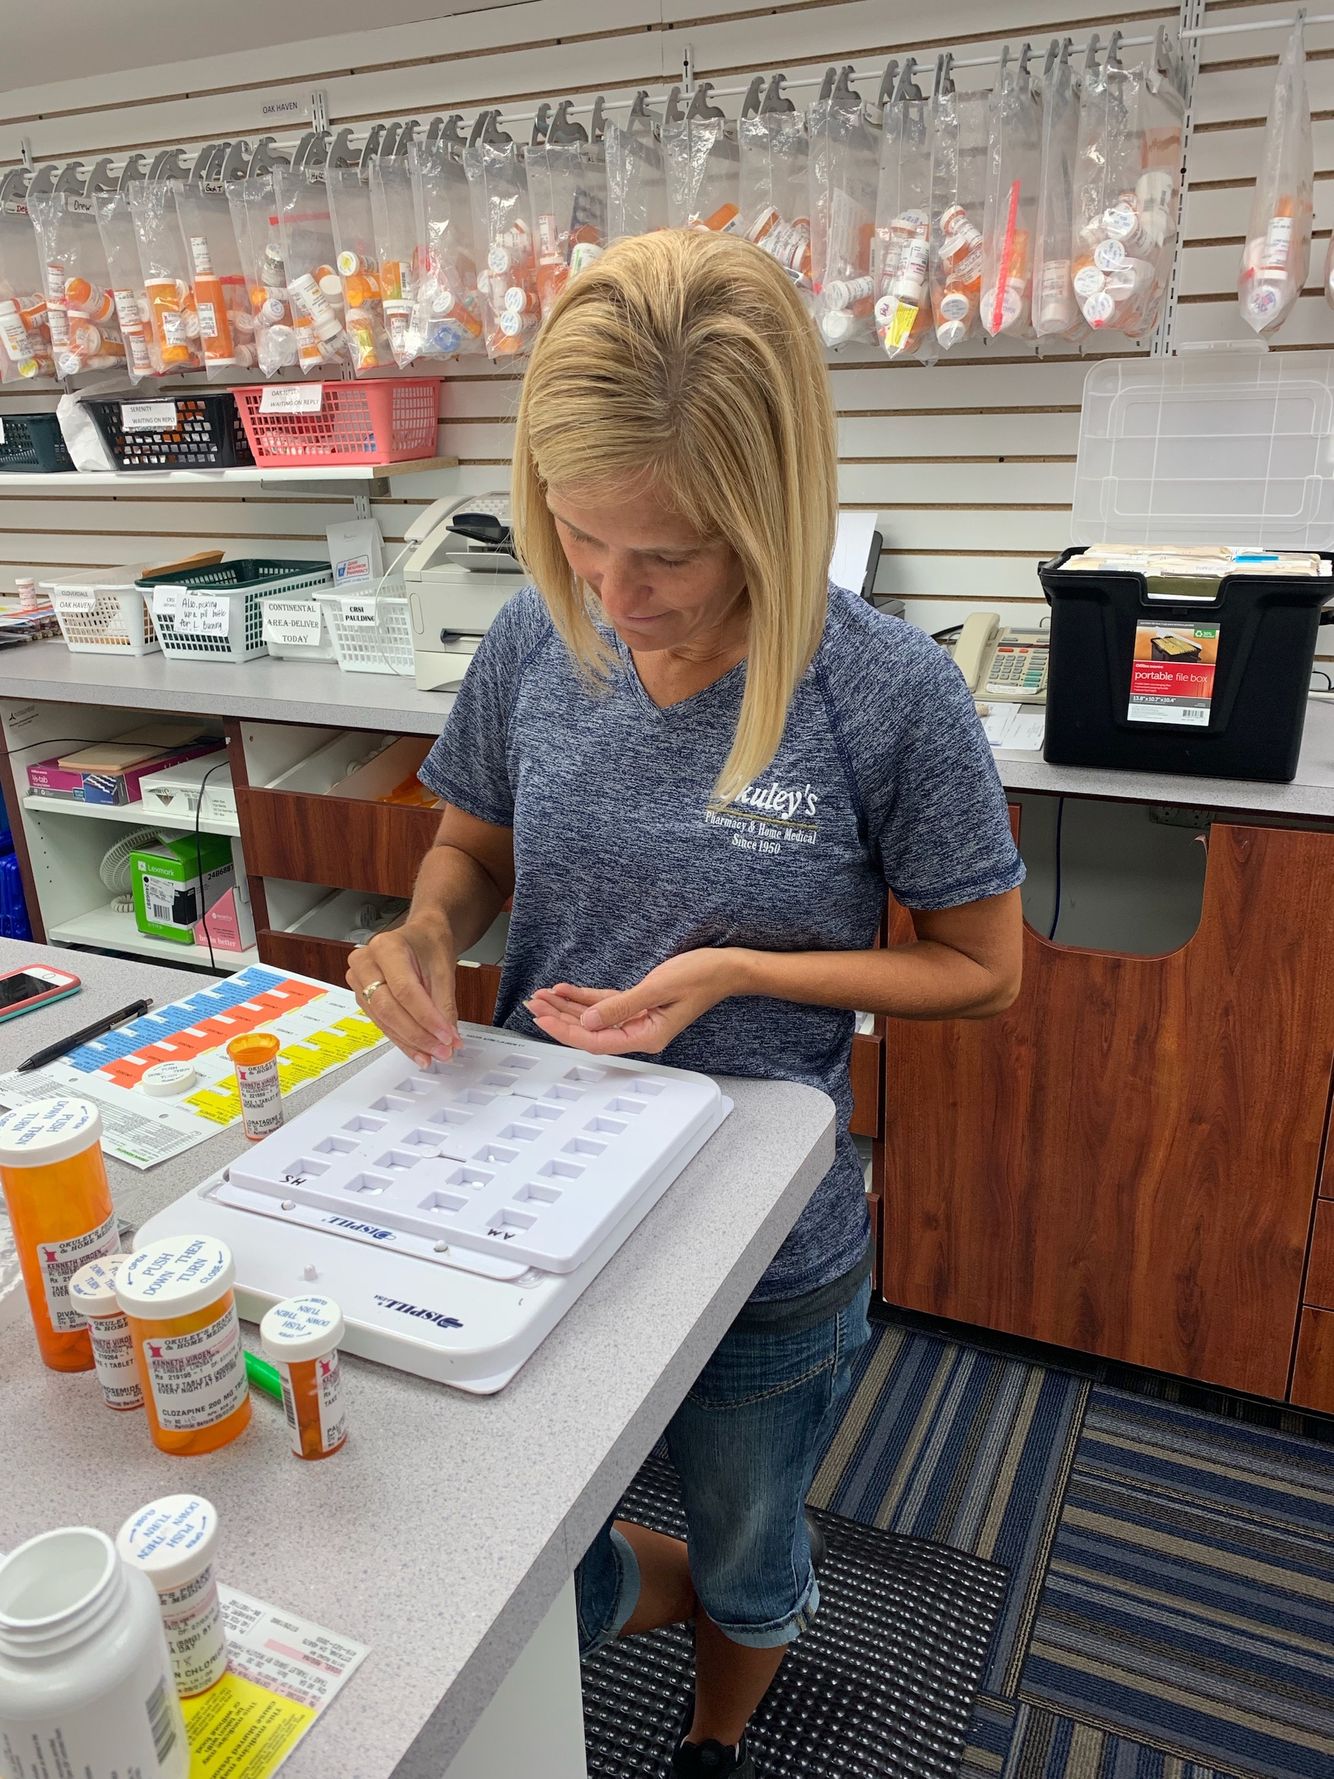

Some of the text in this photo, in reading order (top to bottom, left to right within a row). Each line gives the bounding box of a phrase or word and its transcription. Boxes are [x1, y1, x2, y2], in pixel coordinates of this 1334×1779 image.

[262, 101, 298, 114] OAK HAVEN
[268, 603, 317, 613] CONTINENTAL
[344, 614, 375, 622] PAULDING
[349, 605, 365, 613] CRSI
[266, 618, 320, 629] AREA-DELIVER
[282, 634, 309, 643] TODAY
[1134, 671, 1208, 683] portable file box
[720, 782, 819, 820] kuley's
[704, 810, 817, 845] Pharmacy & Home Medical
[731, 833, 782, 855] Since 1950
[147, 864, 175, 877] Lexmark
[45, 1113, 75, 1133] PUSH
[328, 1215, 397, 1241] DISPILL
[128, 1253, 148, 1271] OPEN
[174, 1239, 207, 1265] THEN
[142, 1252, 175, 1277] PUSH
[176, 1257, 209, 1282] TURN
[199, 1265, 223, 1284] CLOSE
[142, 1270, 175, 1296] DOWN
[273, 1309, 298, 1320] THEN
[297, 1305, 321, 1316] TURN
[383, 1300, 464, 1329] DISPILL
[281, 1320, 306, 1332] PUSH
[305, 1317, 331, 1327] DOWN
[177, 1336, 204, 1350] HOME
[109, 1358, 134, 1368] TABLET
[162, 1405, 206, 1417] CLOZAPINE
[208, 1397, 222, 1410] 200
[134, 1508, 157, 1528] CLOSE
[171, 1500, 201, 1526] DOWN
[143, 1513, 172, 1538] TURN
[166, 1523, 195, 1549] PUSH
[185, 1531, 204, 1550] OPEN
[136, 1535, 167, 1560] THEN
[257, 1700, 276, 1724] cause
[265, 1708, 282, 1724] This
[231, 1724, 258, 1755] blurred
[237, 1725, 267, 1762] medicine
